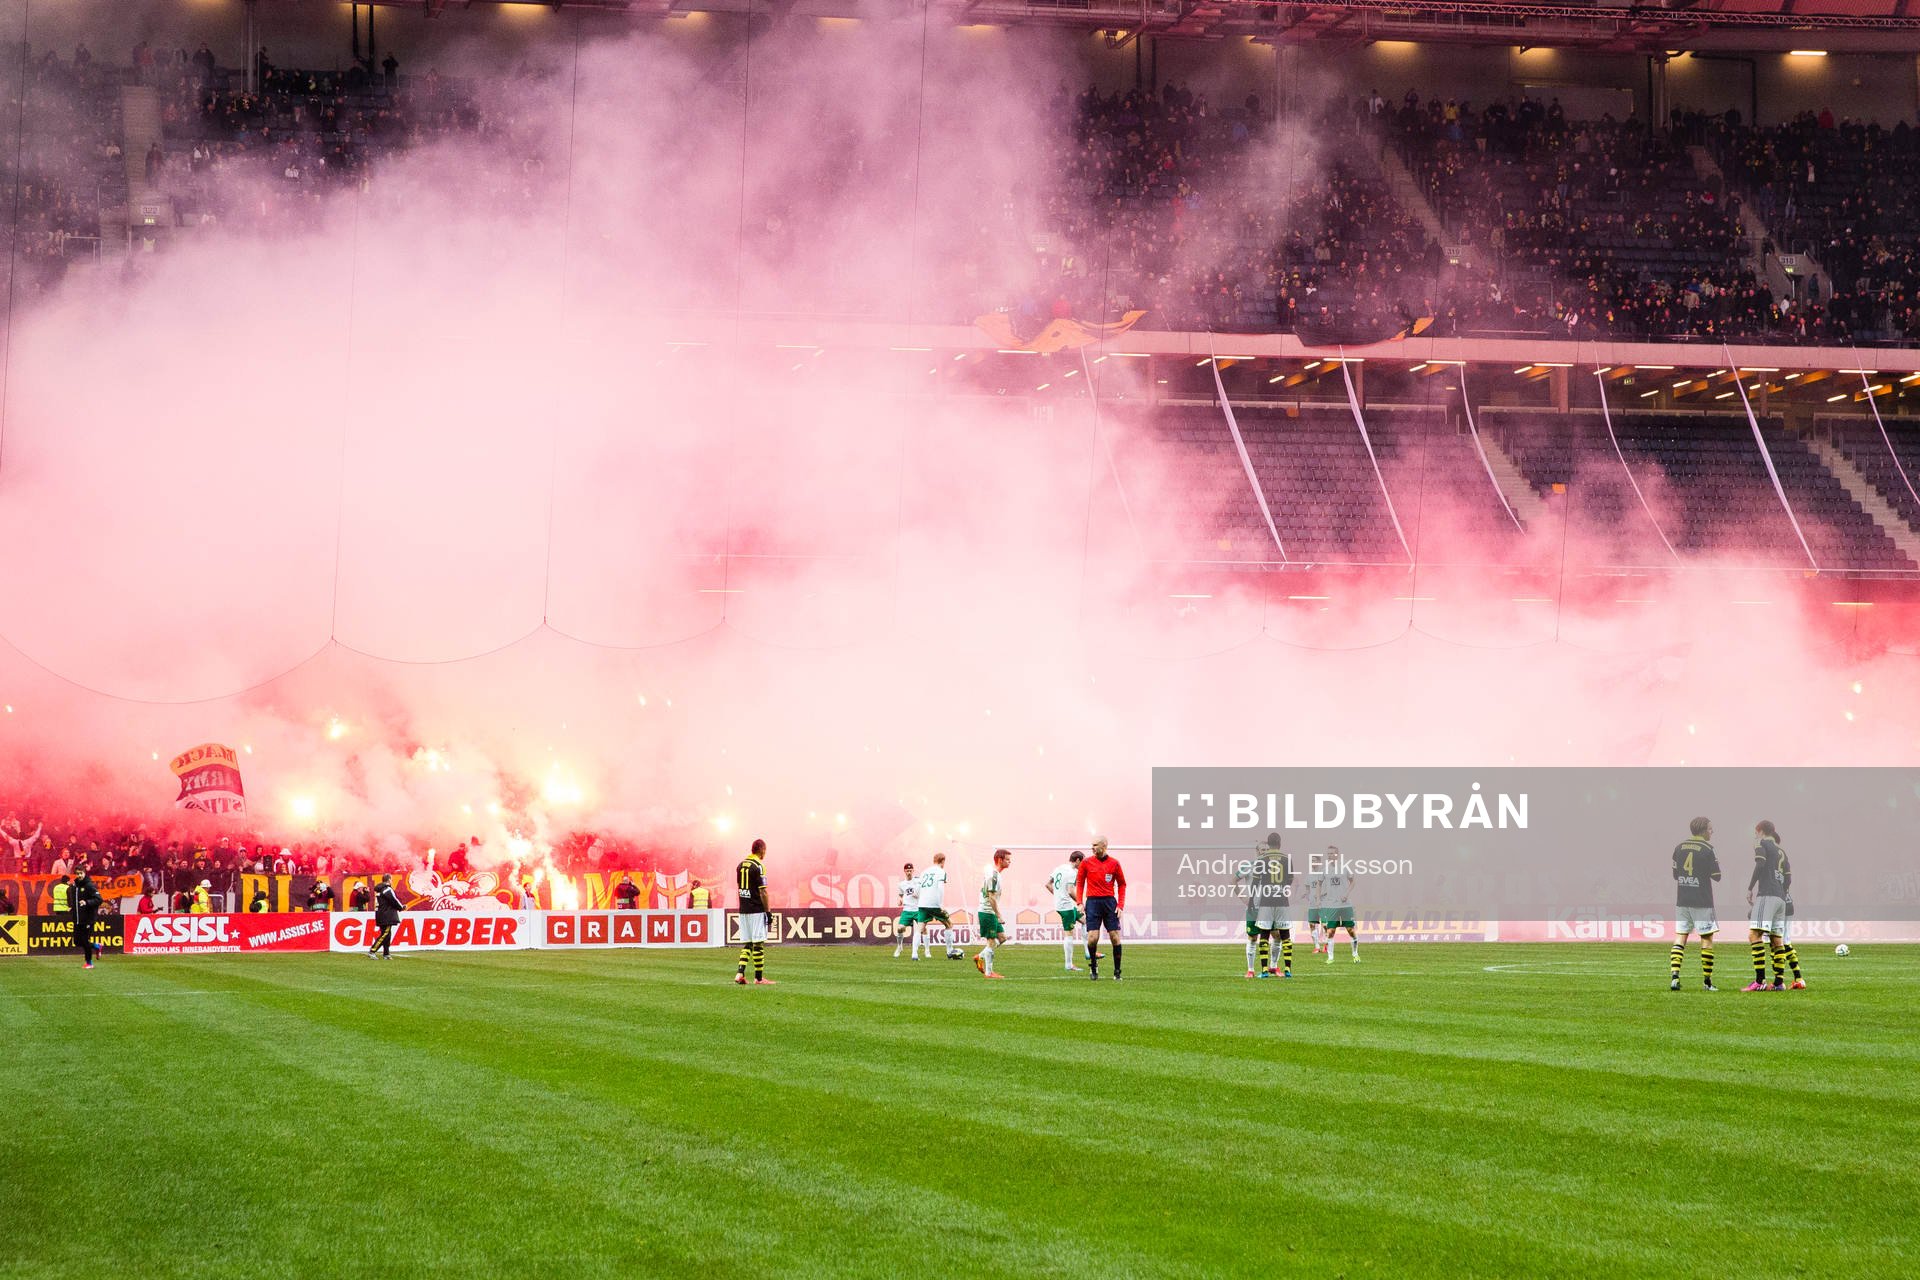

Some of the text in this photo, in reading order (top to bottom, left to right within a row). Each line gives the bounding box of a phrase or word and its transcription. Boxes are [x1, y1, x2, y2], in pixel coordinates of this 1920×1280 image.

[1684, 852, 1693, 876] 4
[740, 868, 749, 889] 11
[921, 873, 935, 888] 23
[1055, 872, 1062, 890] 8
[1678, 876, 1699, 884] SVEA
[42, 922, 111, 932] MASN-
[133, 917, 230, 944] ASSIST
[334, 917, 518, 946] GRABBER
[553, 920, 701, 938] CRAMO
[786, 916, 912, 939] XL-BYGG
[1548, 906, 1665, 939] Kährs
[248, 920, 325, 948] WWW.ASSIST.SE
